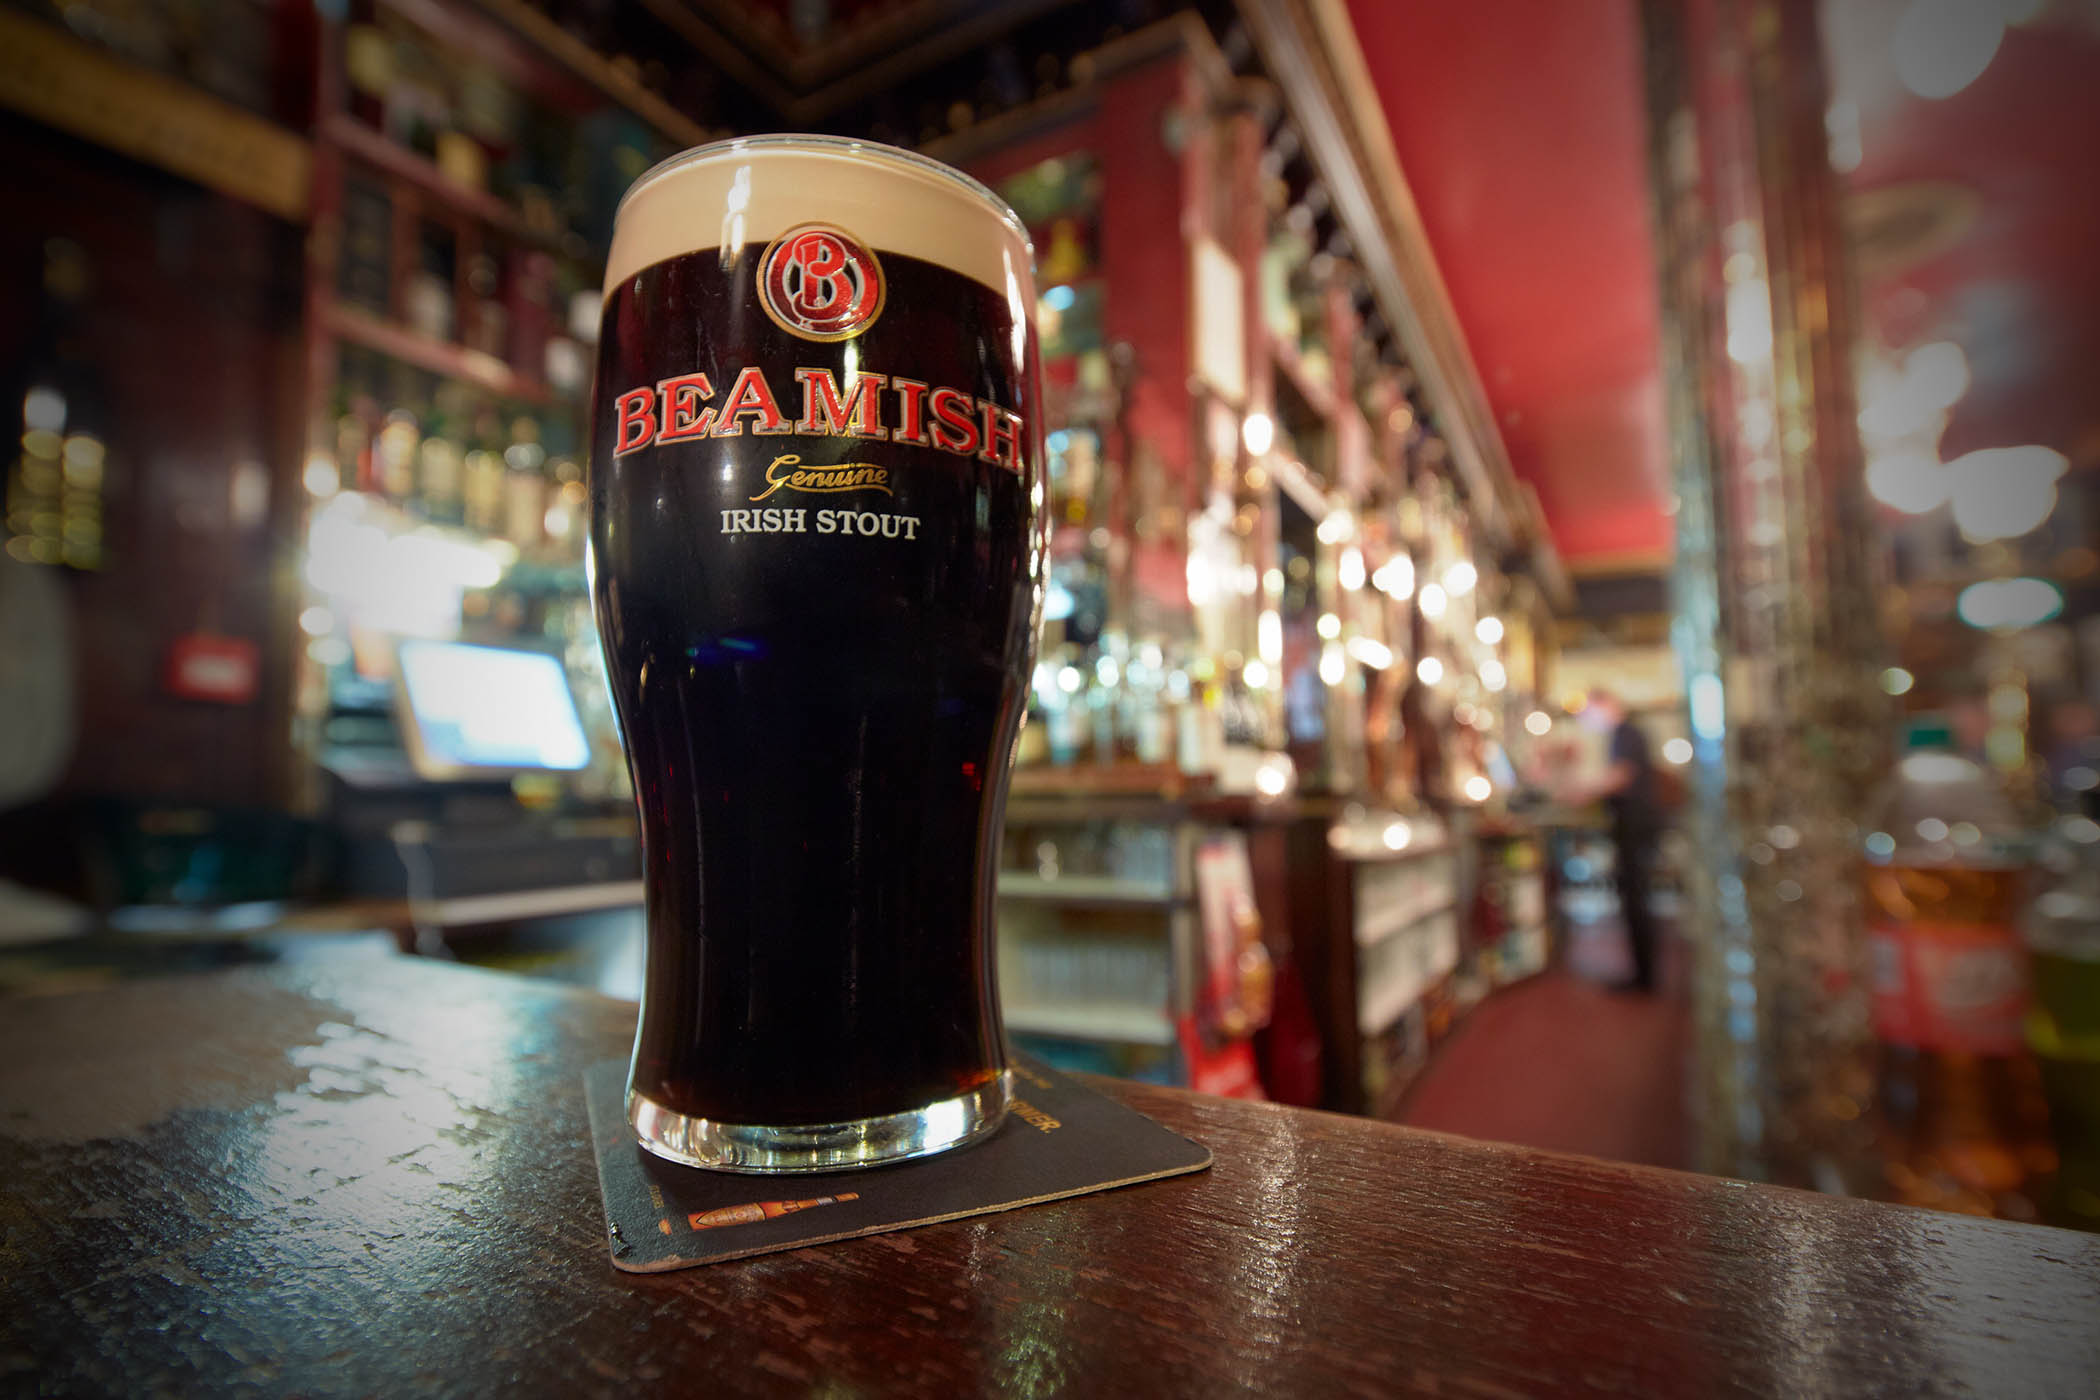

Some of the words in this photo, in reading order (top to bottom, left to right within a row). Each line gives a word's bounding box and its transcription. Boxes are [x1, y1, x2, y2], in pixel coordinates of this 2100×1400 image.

[613, 367, 1025, 475] BEAMISH
[749, 454, 892, 501] Genuine
[720, 508, 807, 534] IRISH
[816, 509, 920, 540] STOUT
